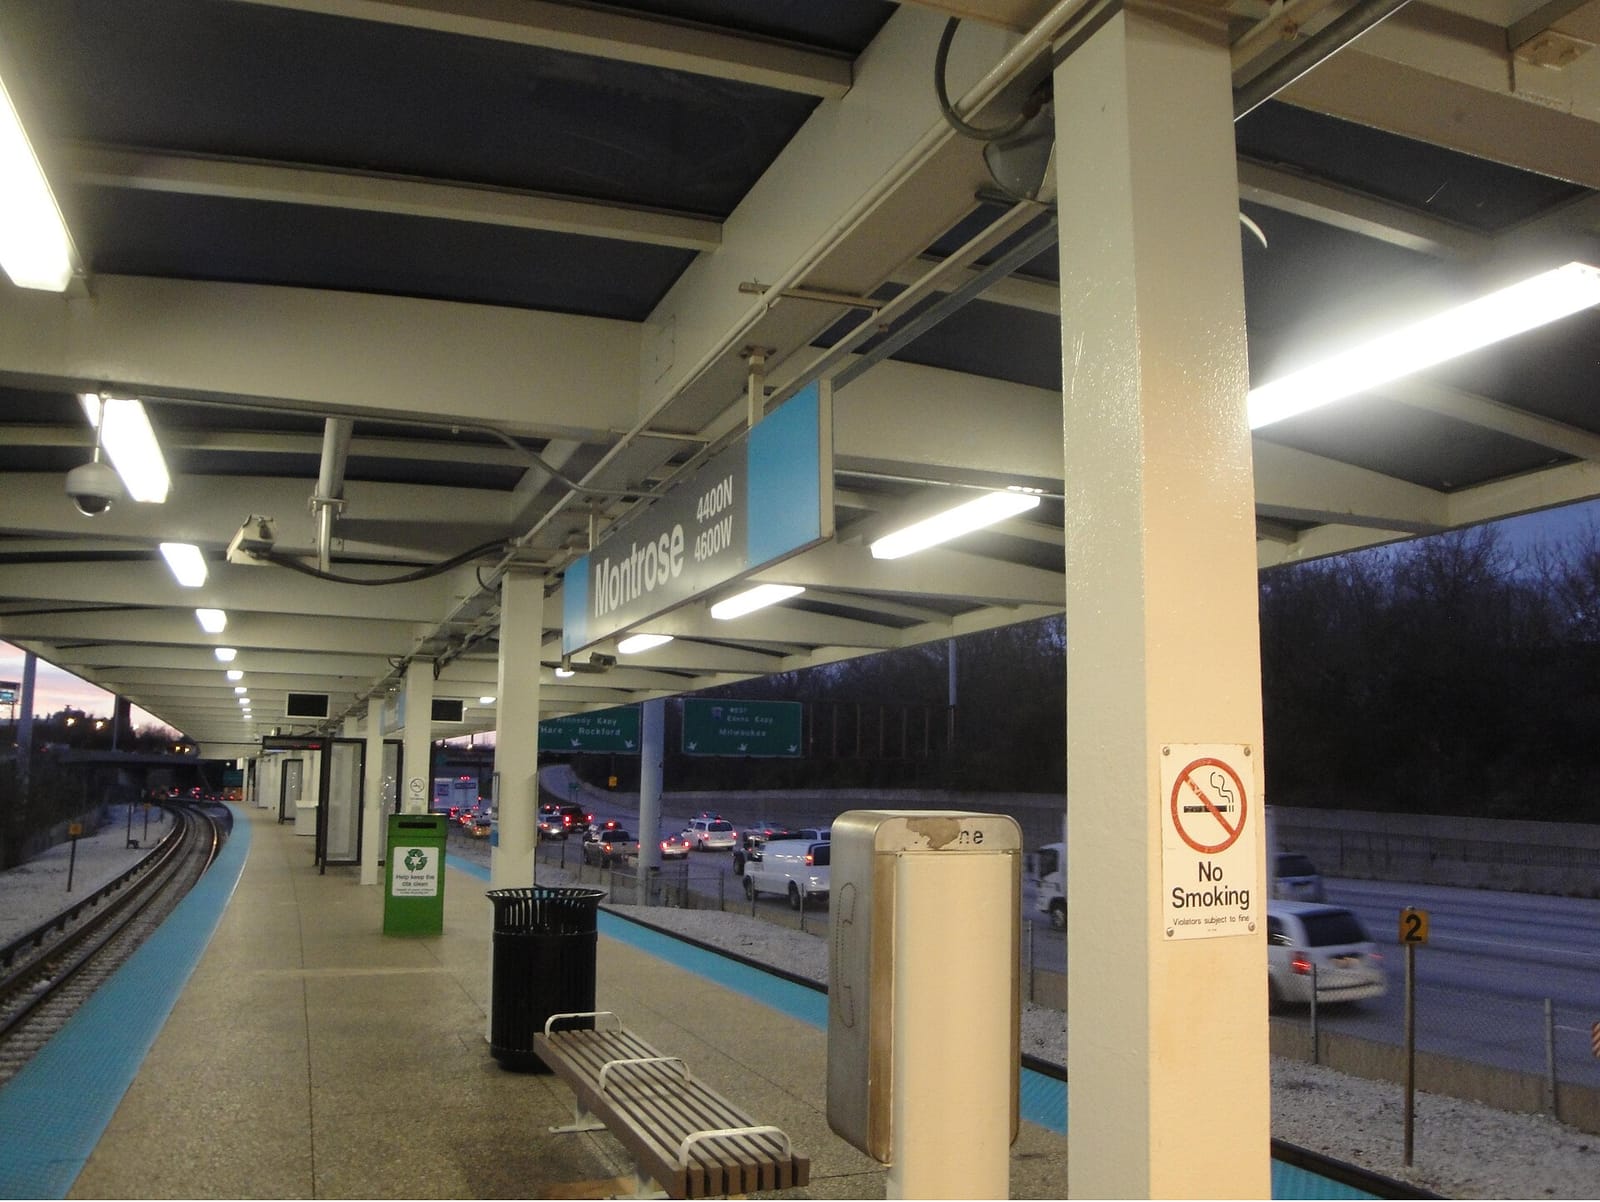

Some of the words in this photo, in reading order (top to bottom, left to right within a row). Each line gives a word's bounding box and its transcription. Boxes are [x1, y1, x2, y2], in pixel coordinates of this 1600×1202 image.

[696, 475, 733, 523] 4400N
[694, 514, 733, 562] 4600W
[594, 523, 685, 618] Montrose
[578, 727, 621, 737] Rockford
[1198, 861, 1224, 882] No
[1172, 884, 1250, 910] Smoking
[1173, 917, 1202, 926] Violators
[1204, 916, 1227, 926] subject
[1229, 915, 1237, 923] to
[1238, 914, 1250, 922] fine
[1405, 913, 1423, 942] 2
